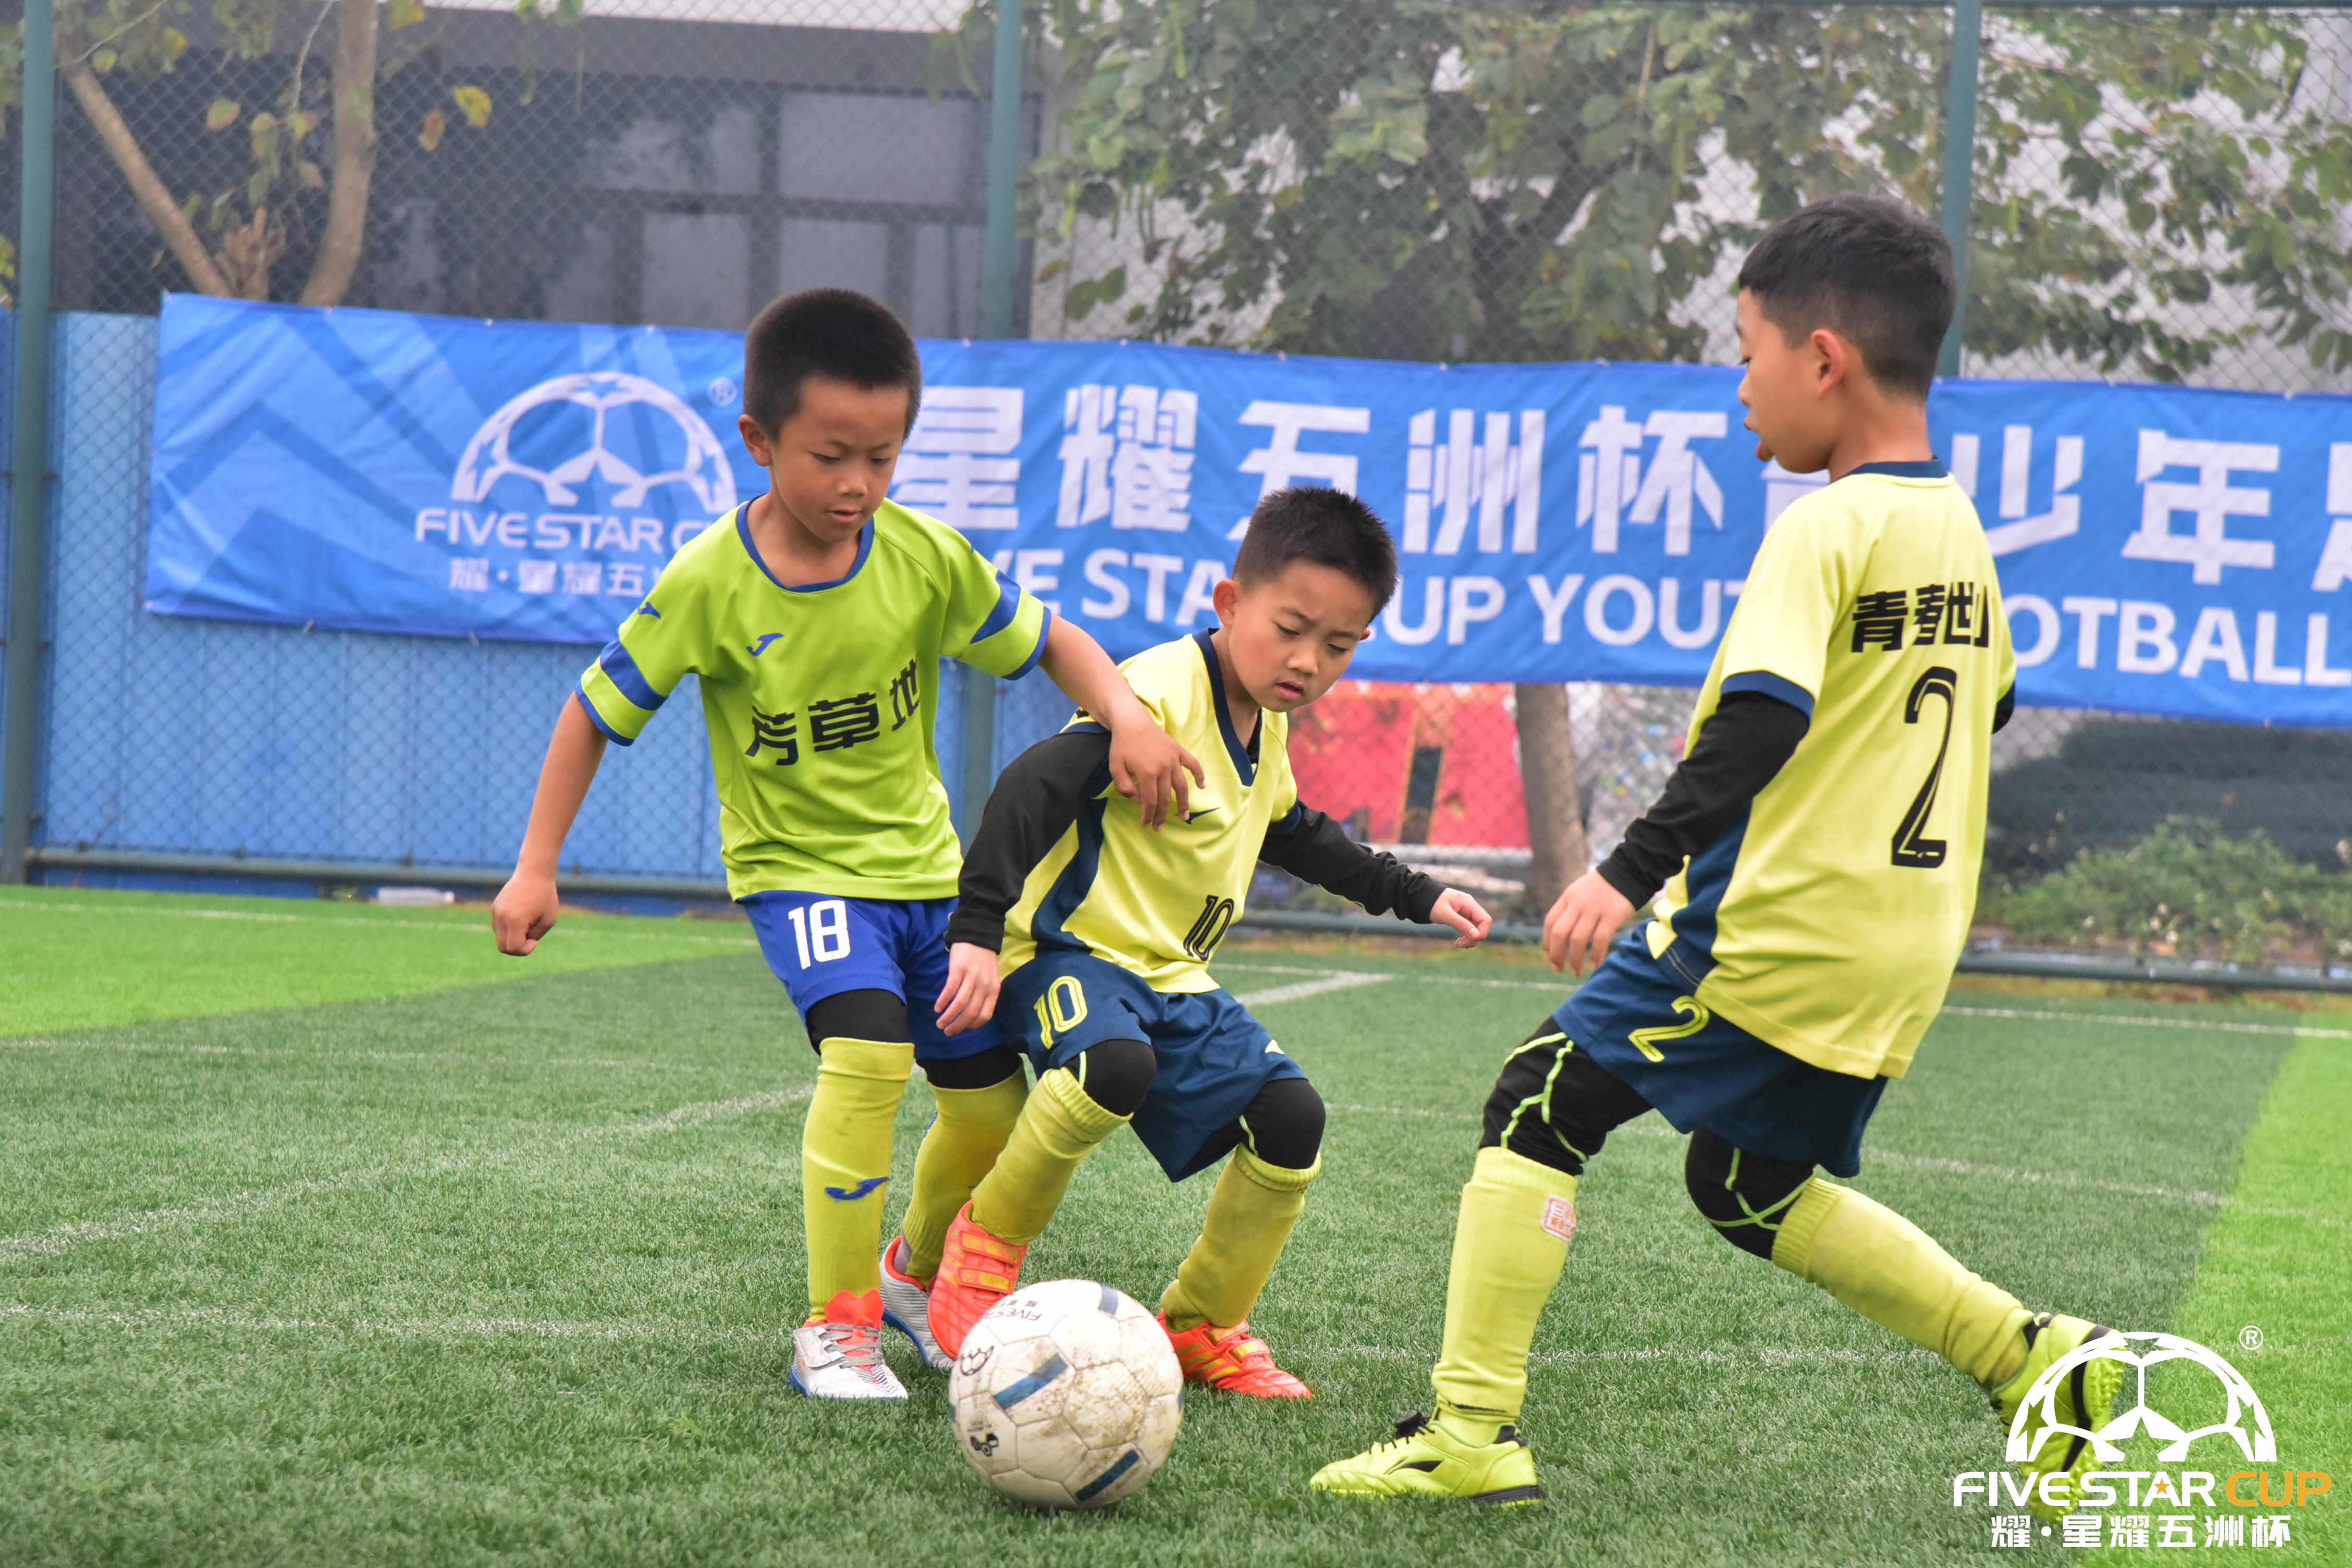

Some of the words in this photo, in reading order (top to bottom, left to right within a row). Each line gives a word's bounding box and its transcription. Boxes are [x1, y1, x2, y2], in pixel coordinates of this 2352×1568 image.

[416, 508, 528, 547] FIVE
[534, 513, 664, 554] STAR
[1081, 547, 1222, 626] STA
[1372, 574, 1506, 646] UP
[1525, 573, 1747, 650] YOU
[2002, 594, 2352, 687] OTBALL
[1891, 666, 1957, 868] 2
[788, 900, 851, 970] 18
[1183, 894, 1234, 961] 10
[1033, 975, 1088, 1049] 10
[1627, 995, 1710, 1062] 2
